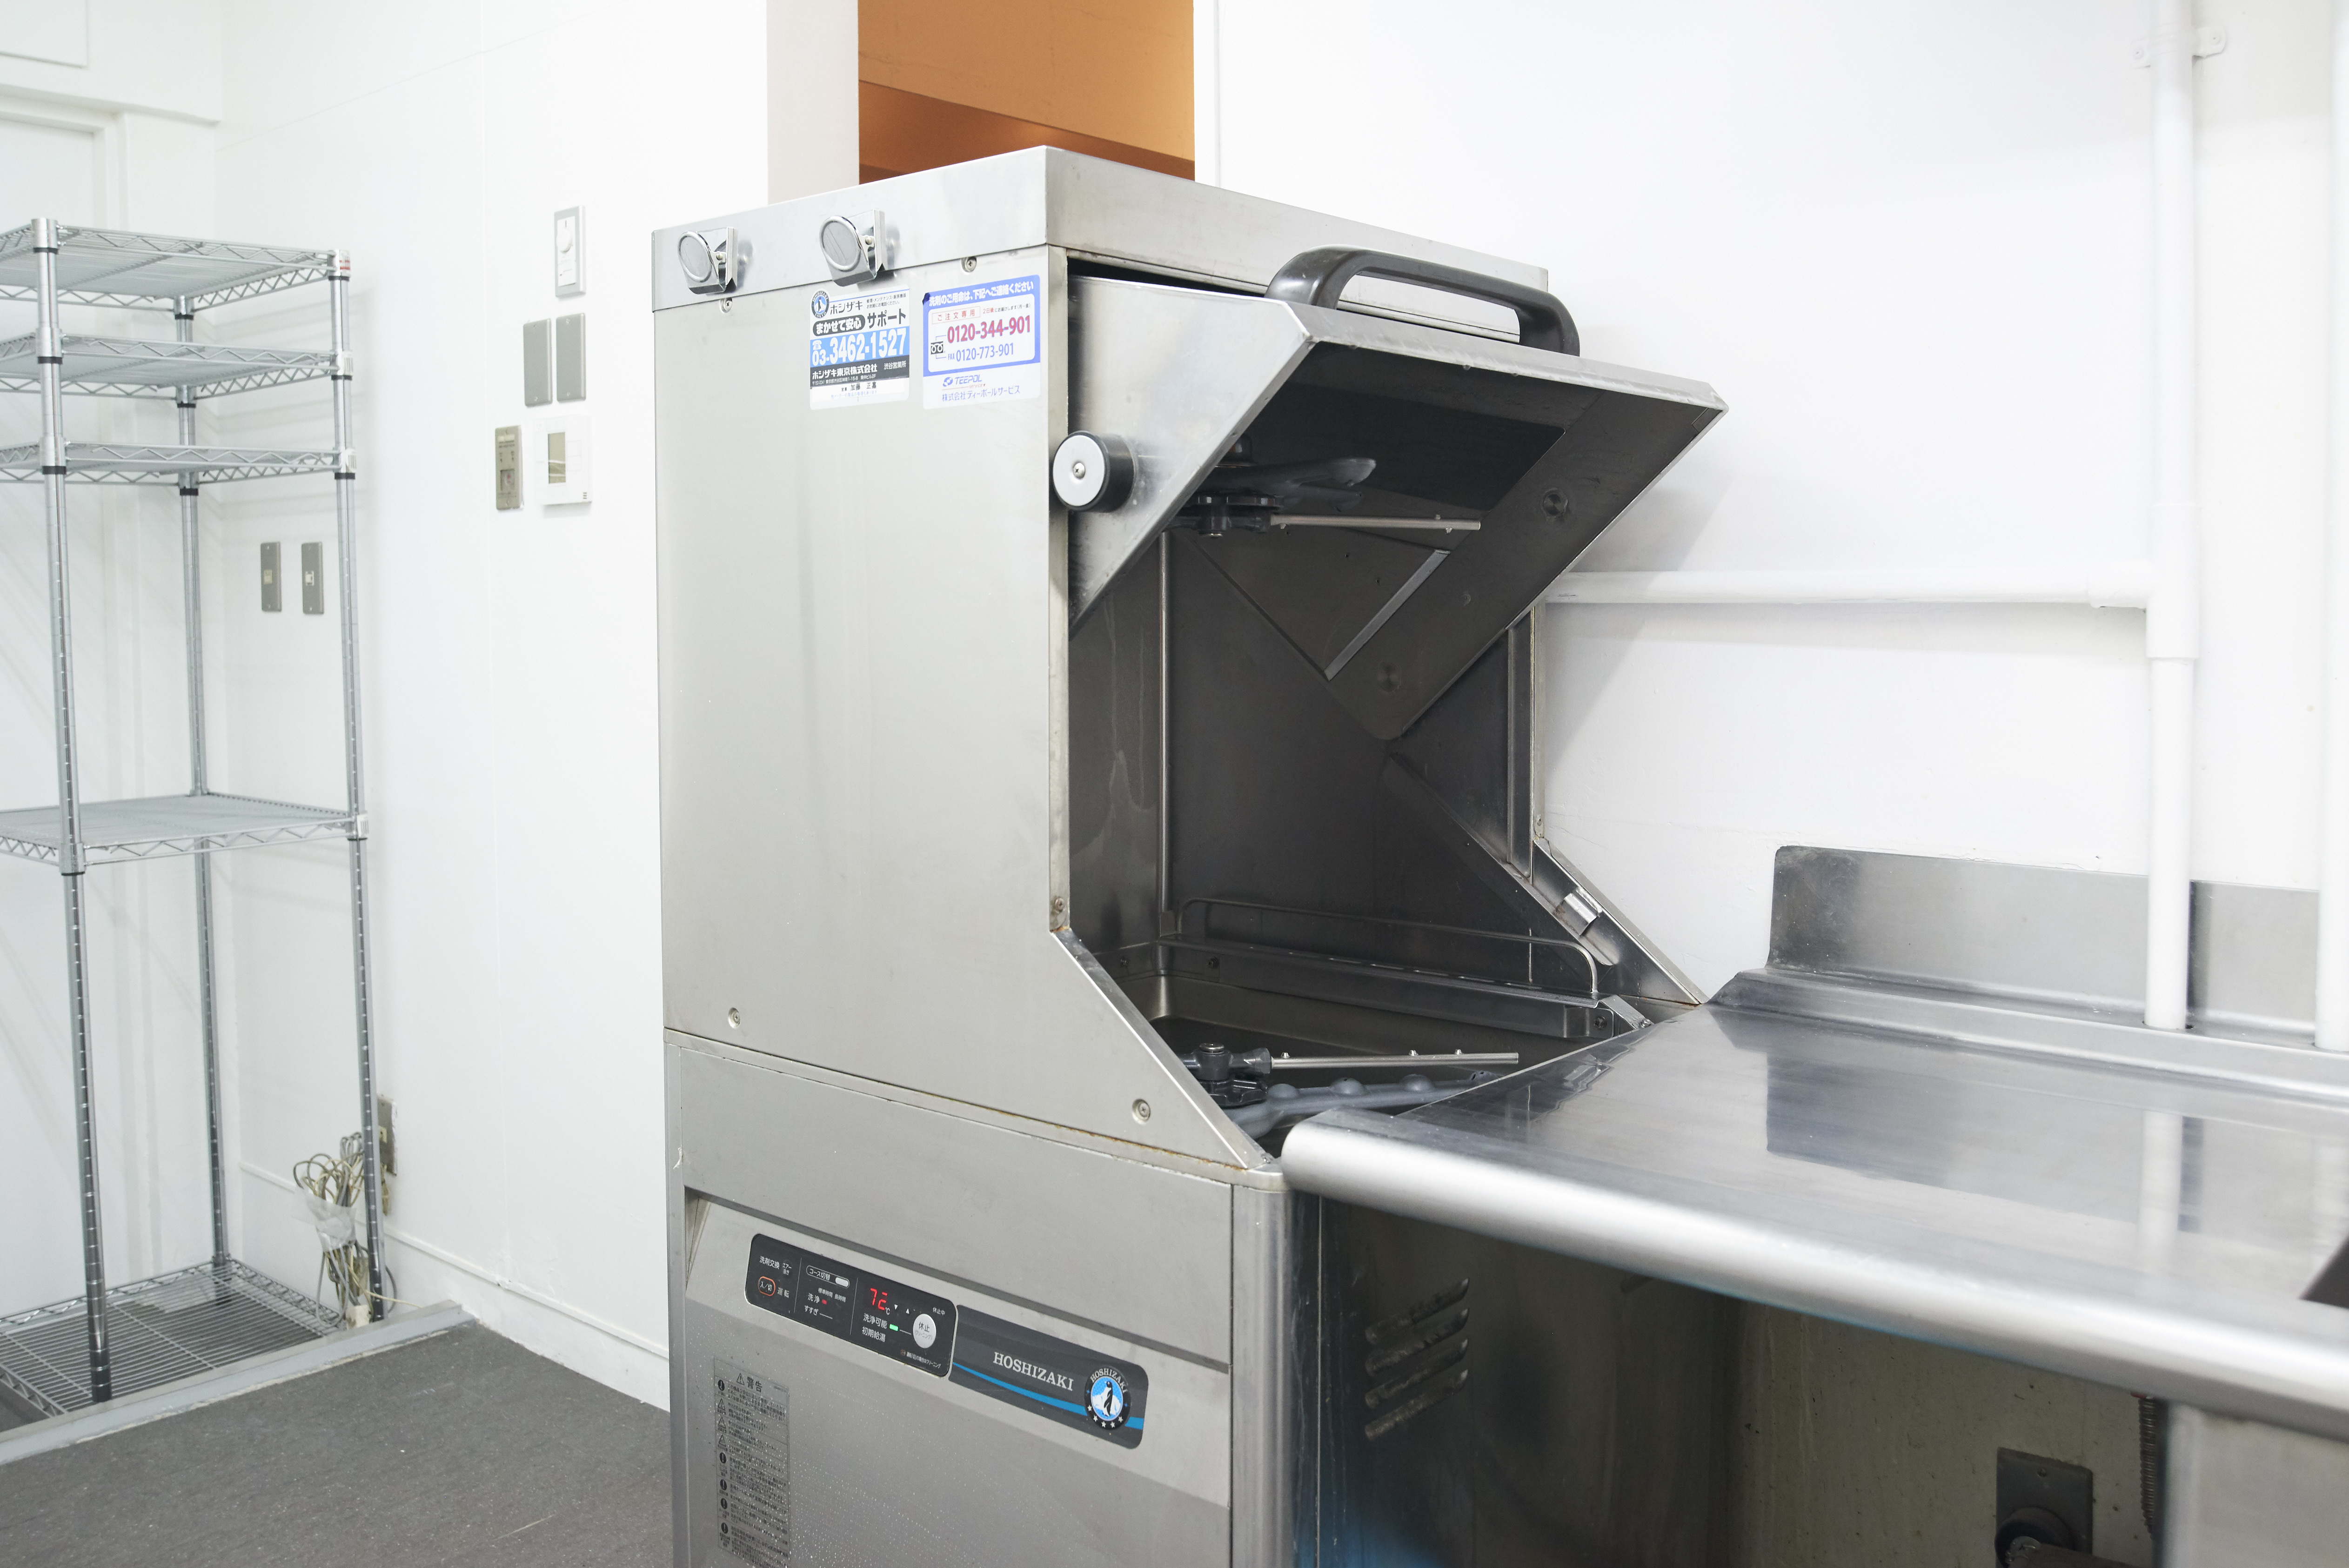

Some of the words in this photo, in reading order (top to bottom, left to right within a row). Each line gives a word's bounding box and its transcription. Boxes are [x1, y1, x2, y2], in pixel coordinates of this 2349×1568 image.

[830, 301, 863, 315] ホシザキ
[937, 309, 975, 321] ご注文専用
[816, 317, 862, 335] まかせて安心
[867, 308, 906, 328] サポート
[947, 315, 1030, 343] 0120-344-901
[812, 328, 906, 366] 03-3462-1527
[956, 343, 1014, 362] 0120-773-901
[812, 363, 877, 380] ホシザキ東京株式会社
[955, 374, 982, 385] TEEPOL
[759, 1255, 780, 1270] 洗剤交換
[809, 1268, 830, 1281] コース切替
[807, 1293, 820, 1304] 洗浄
[804, 1305, 819, 1316] すすぎ
[932, 1307, 945, 1316] 休止中
[863, 1313, 887, 1329] 洗浄可能
[918, 1321, 930, 1333] 休止
[862, 1326, 886, 1343] 初期給湯
[993, 1351, 1074, 1391] HOSHIZAKI
[746, 1376, 763, 1393] 警告
[1090, 1368, 1128, 1394] HOSHIZAKI
